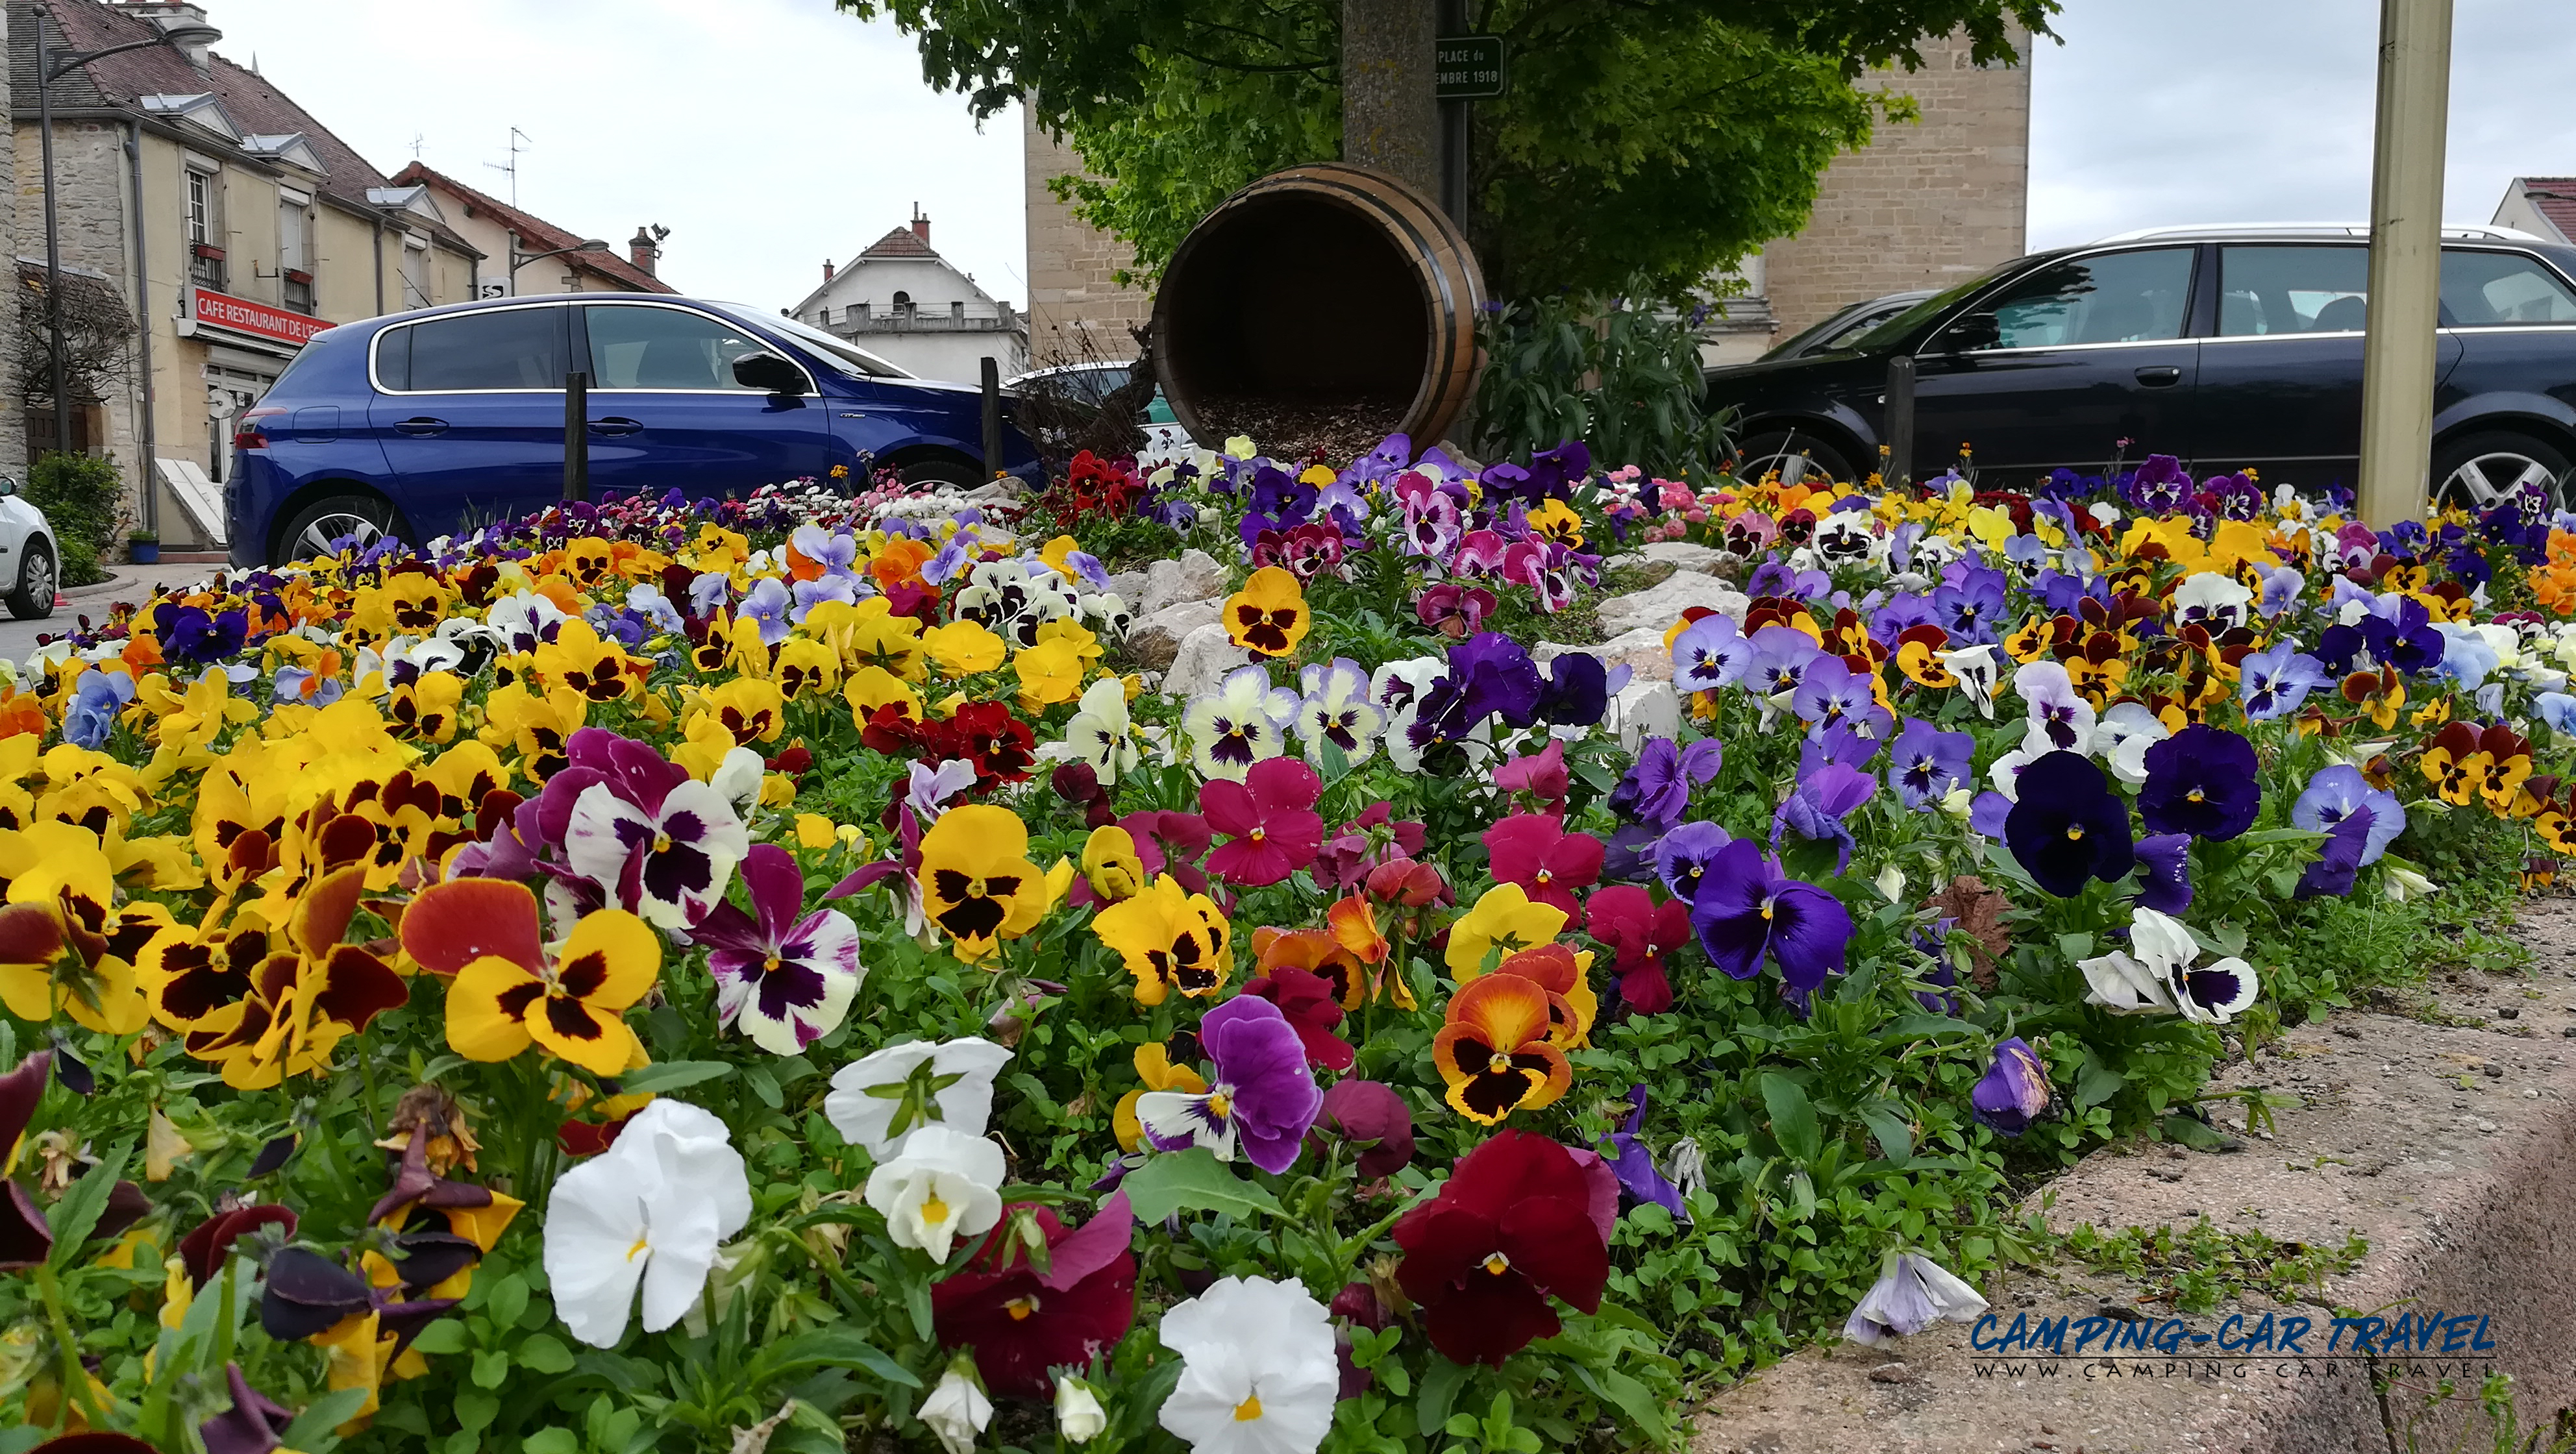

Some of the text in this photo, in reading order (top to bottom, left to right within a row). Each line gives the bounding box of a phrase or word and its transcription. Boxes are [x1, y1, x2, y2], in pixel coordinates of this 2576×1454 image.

[1438, 49, 1484, 63] PLACE du
[1473, 70, 1498, 83] 1918
[197, 297, 225, 319] CAFE
[227, 304, 288, 334] RESTAURANT
[289, 319, 301, 338] DE
